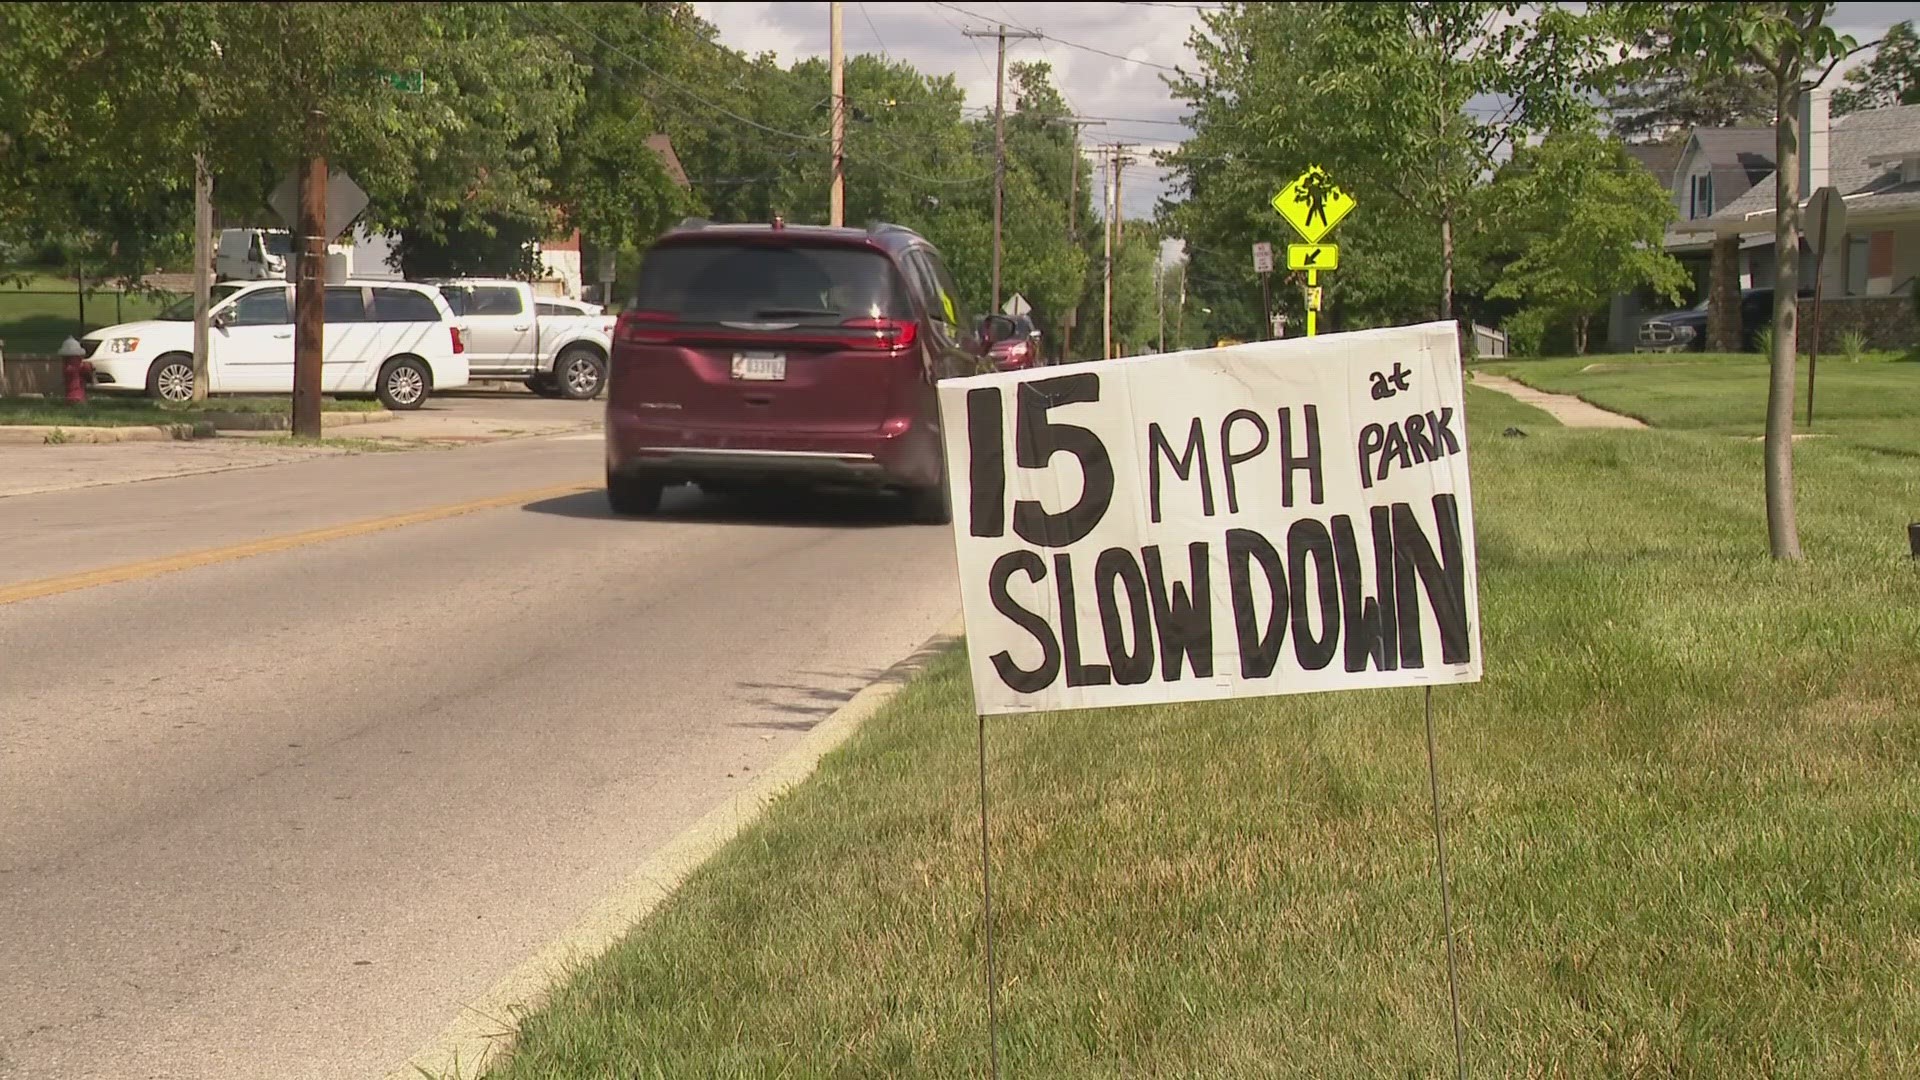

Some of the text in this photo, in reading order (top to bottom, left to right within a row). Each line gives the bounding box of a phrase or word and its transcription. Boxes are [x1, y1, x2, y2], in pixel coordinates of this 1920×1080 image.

[1369, 362, 1412, 401] at
[966, 372, 1324, 548] 15 MPH
[1358, 407, 1461, 490] PARK
[988, 493, 1471, 694] SLOW DOWN
